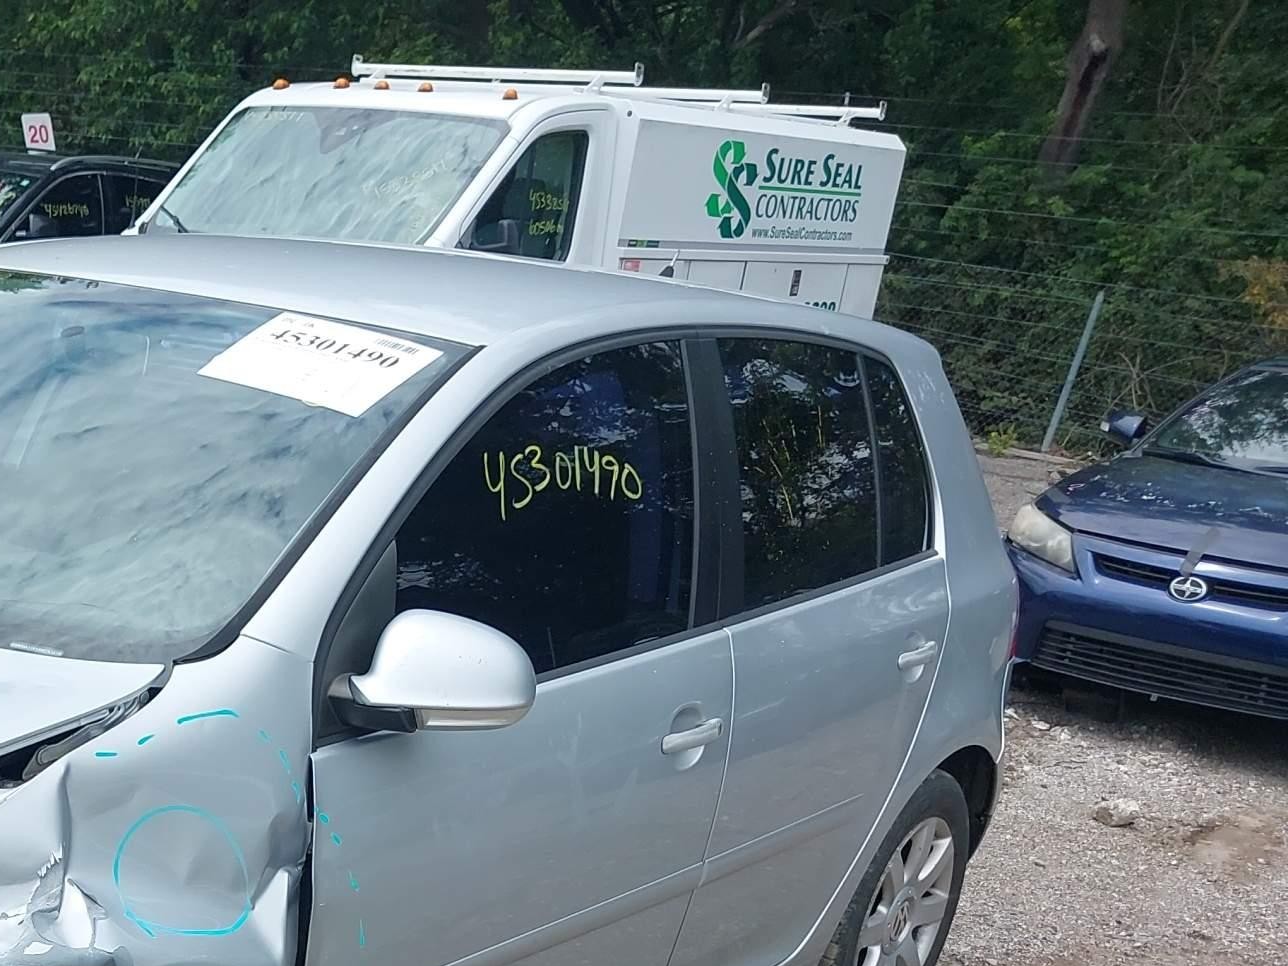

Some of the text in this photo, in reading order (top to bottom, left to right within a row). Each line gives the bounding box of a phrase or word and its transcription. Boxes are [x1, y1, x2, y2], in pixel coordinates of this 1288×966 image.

[28, 124, 49, 144] 20
[755, 194, 859, 223] CONTRACTORS
[751, 225, 853, 242] www.SureSealContractors.com
[270, 329, 400, 369] 45301490
[483, 445, 643, 521] 45301490
